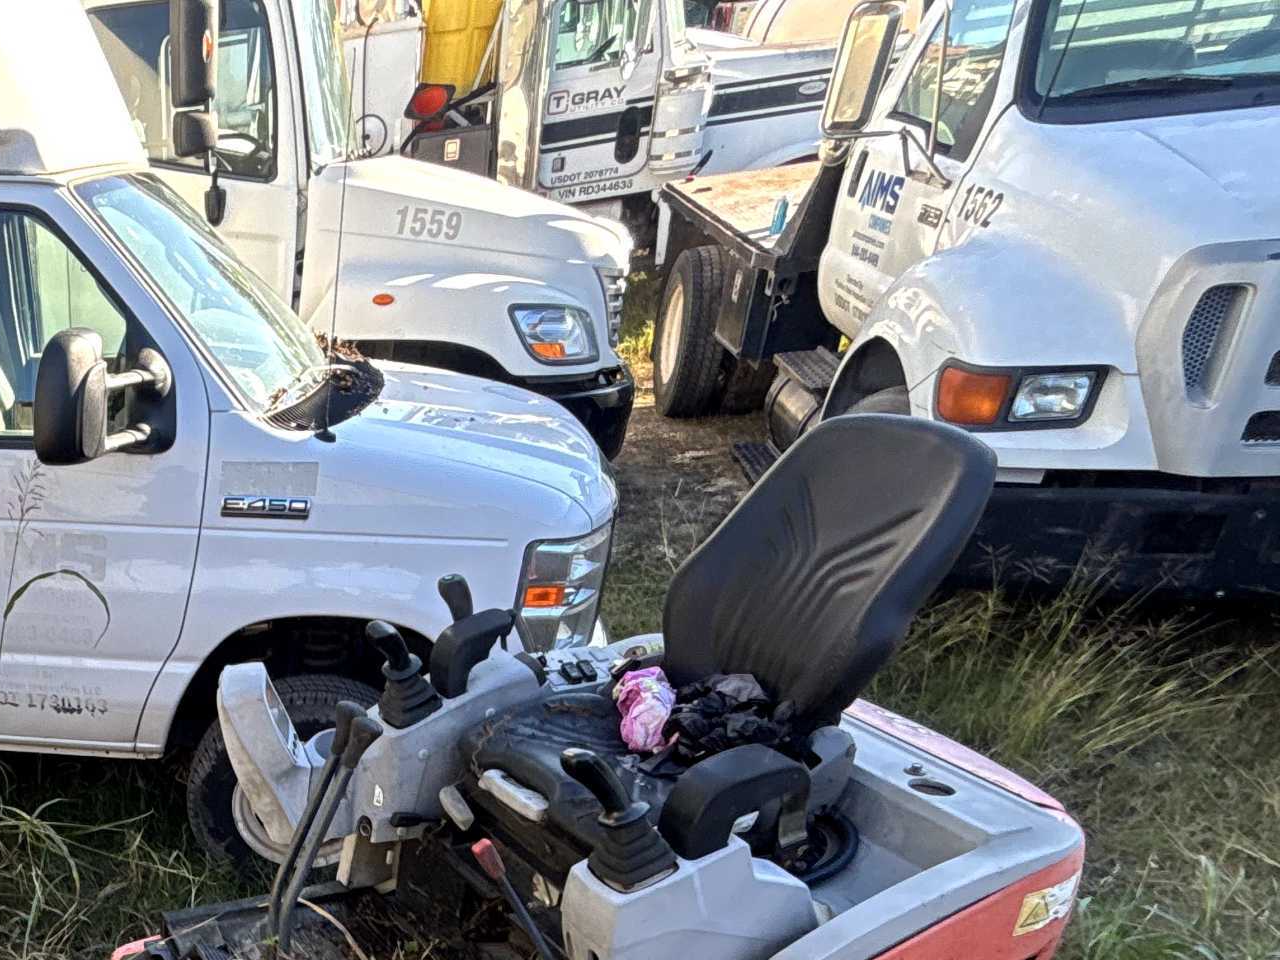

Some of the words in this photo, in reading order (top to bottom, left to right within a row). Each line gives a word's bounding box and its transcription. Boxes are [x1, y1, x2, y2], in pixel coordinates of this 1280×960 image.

[572, 85, 626, 105] GRAY
[550, 172, 582, 185] USDOT
[858, 169, 905, 215] AIMS
[558, 188, 577, 199] VIN
[957, 183, 1004, 228] 1562
[396, 206, 462, 240] 1559
